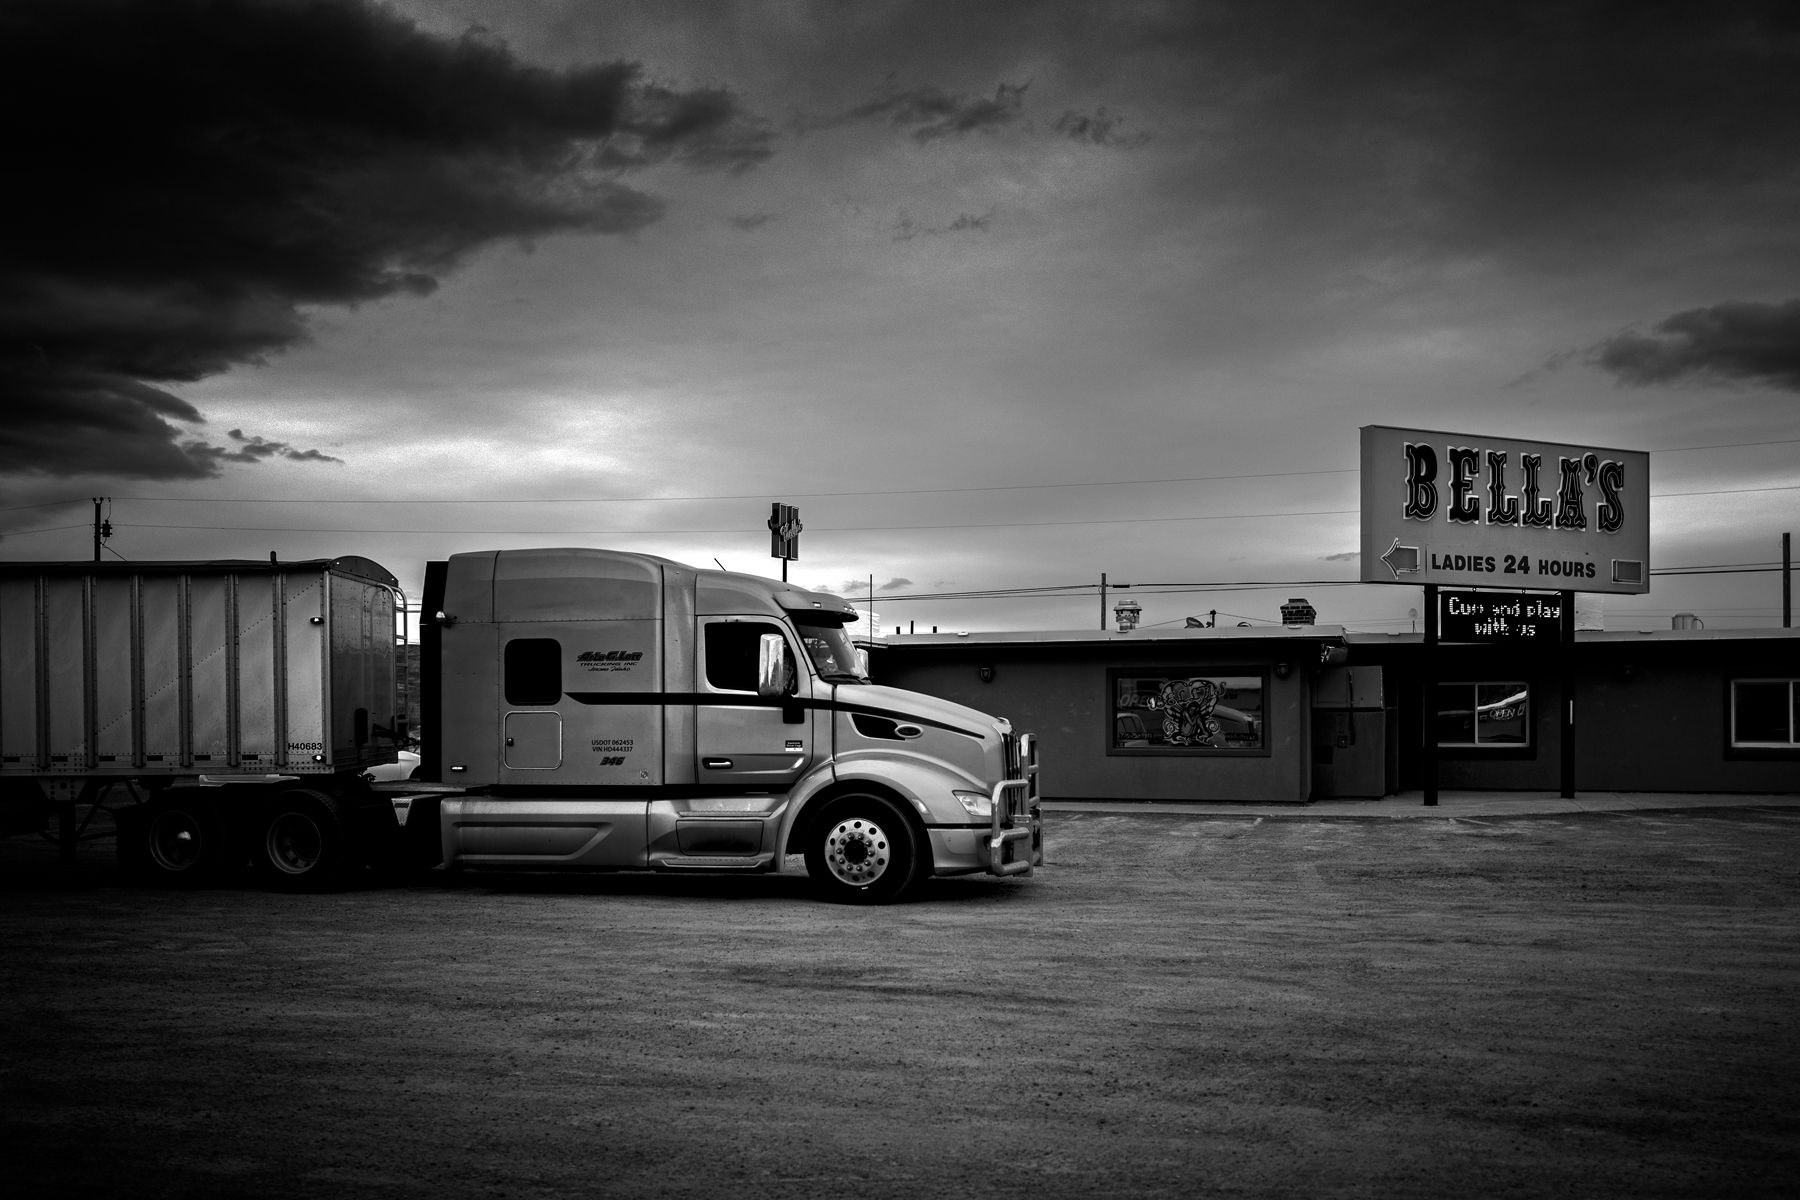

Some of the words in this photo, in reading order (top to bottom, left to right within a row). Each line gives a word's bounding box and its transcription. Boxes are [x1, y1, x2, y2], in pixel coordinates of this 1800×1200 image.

[1403, 441, 1624, 534] BELLA'S
[1431, 553, 1496, 573] LADIES
[1503, 555, 1530, 575] 24
[1538, 559, 1596, 579] HOURS
[1526, 600, 1561, 618] play
[288, 742, 323, 750] H40683
